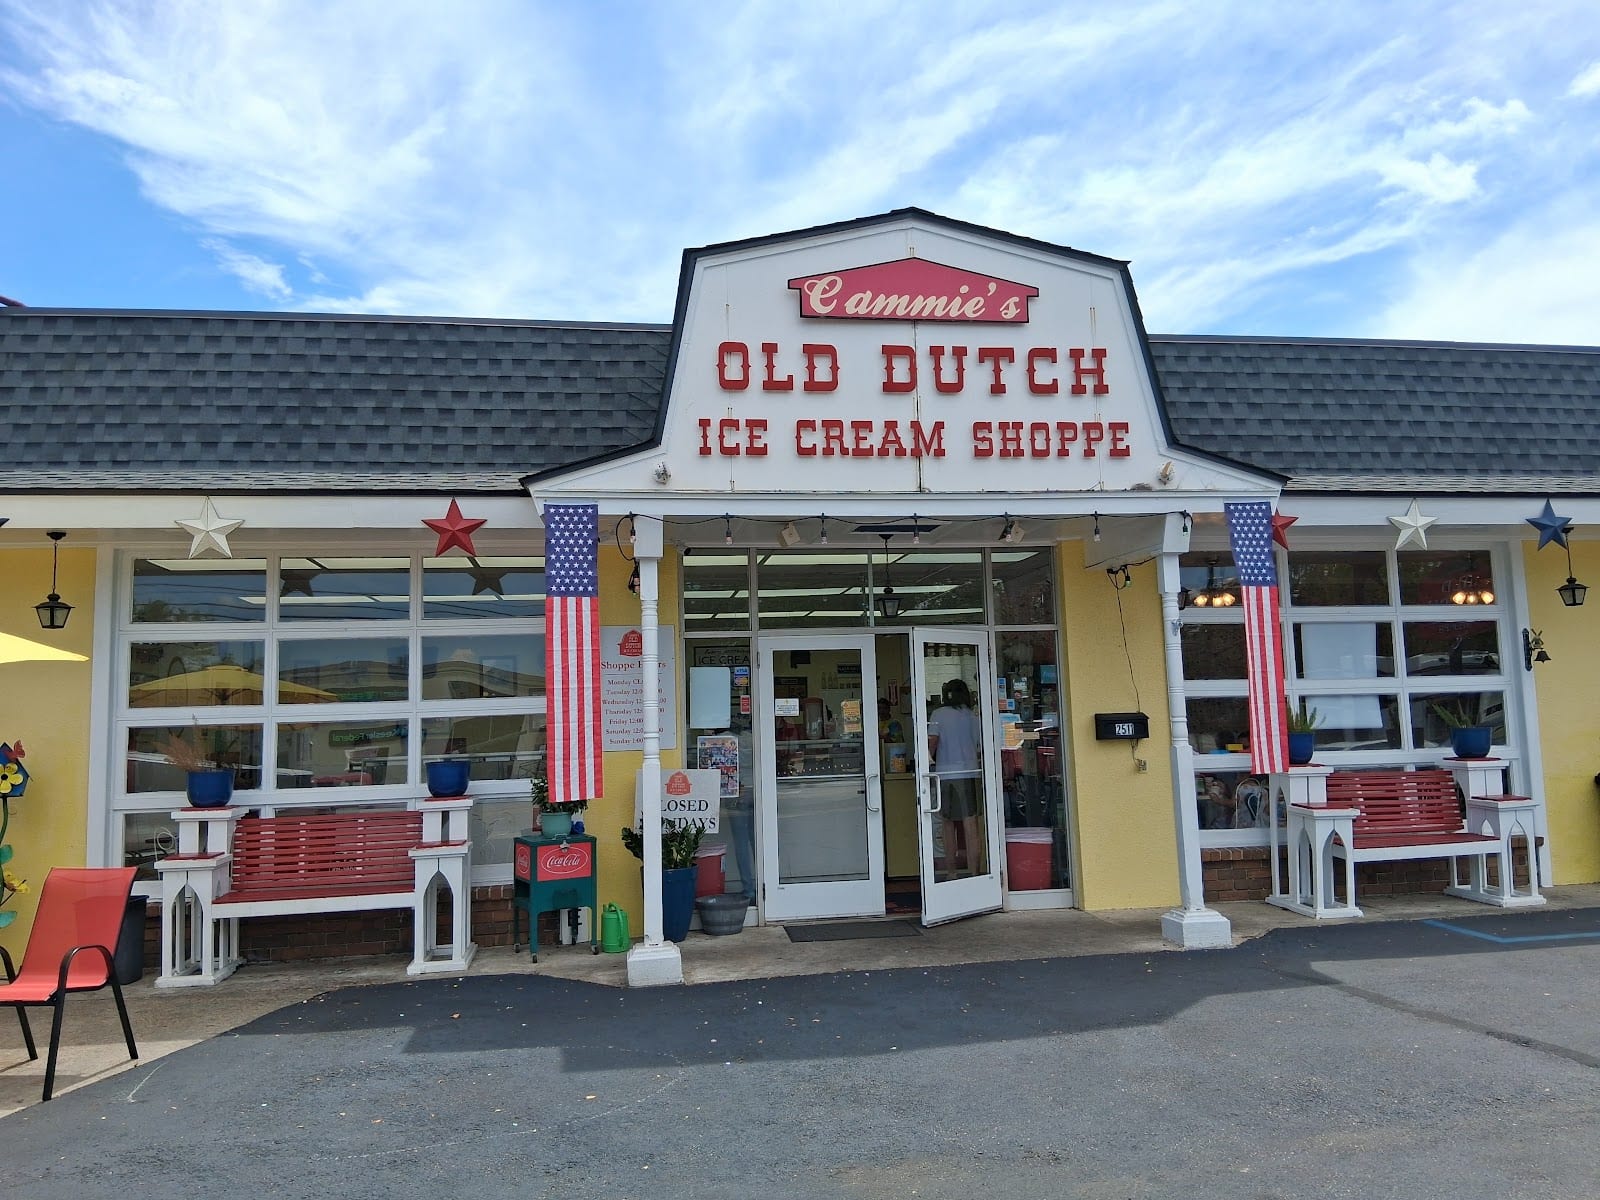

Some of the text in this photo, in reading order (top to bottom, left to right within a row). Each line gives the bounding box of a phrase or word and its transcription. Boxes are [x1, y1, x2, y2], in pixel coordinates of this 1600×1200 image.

[804, 276, 1020, 320] Cammie's
[716, 342, 1109, 394] OLD DUTCH
[699, 418, 1131, 457] ICE CREAM SHOPPE
[601, 661, 635, 671] Shoppe
[698, 655, 750, 665] ICE CREA
[607, 679, 631, 687] Monday
